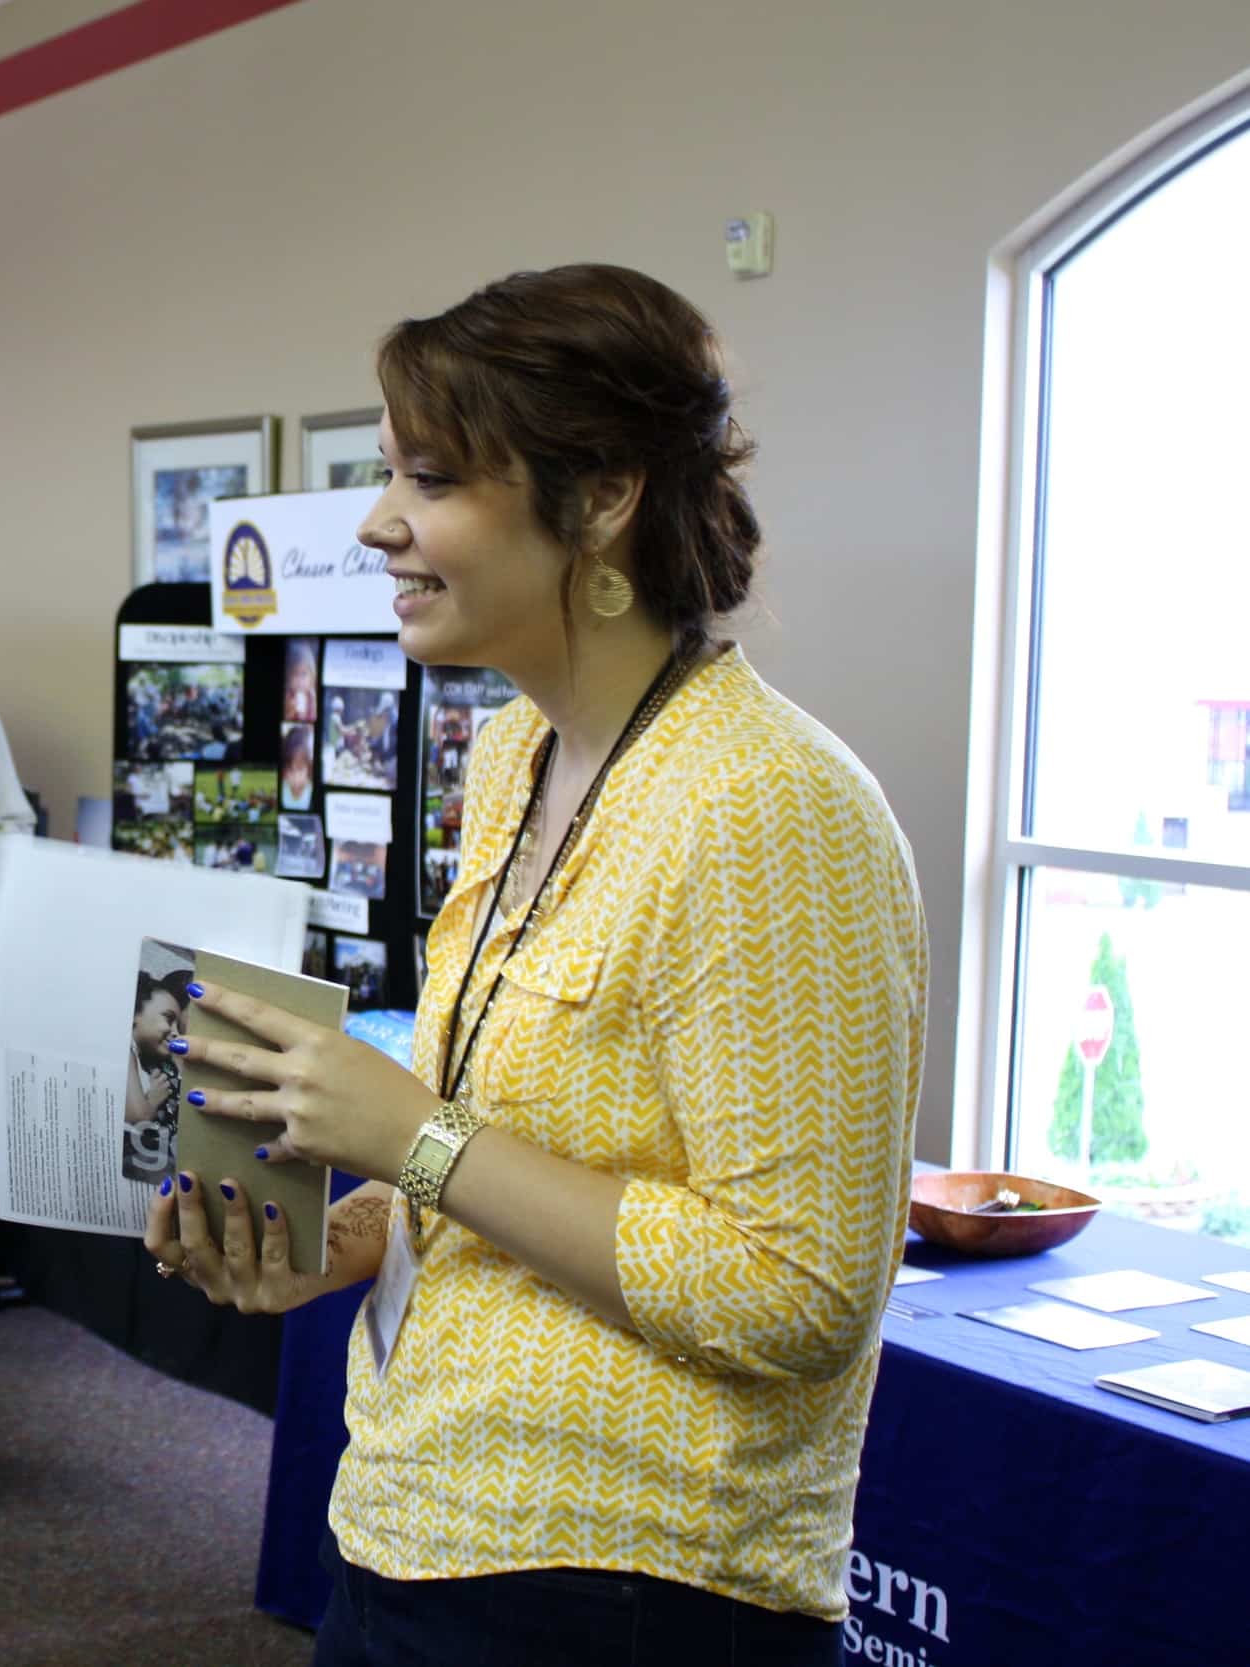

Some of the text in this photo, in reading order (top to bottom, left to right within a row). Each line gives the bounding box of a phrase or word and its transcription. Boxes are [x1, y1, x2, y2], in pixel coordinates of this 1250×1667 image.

[282, 547, 335, 579] Chosen
[130, 1120, 178, 1172] g
[843, 1615, 936, 1667] Semi
